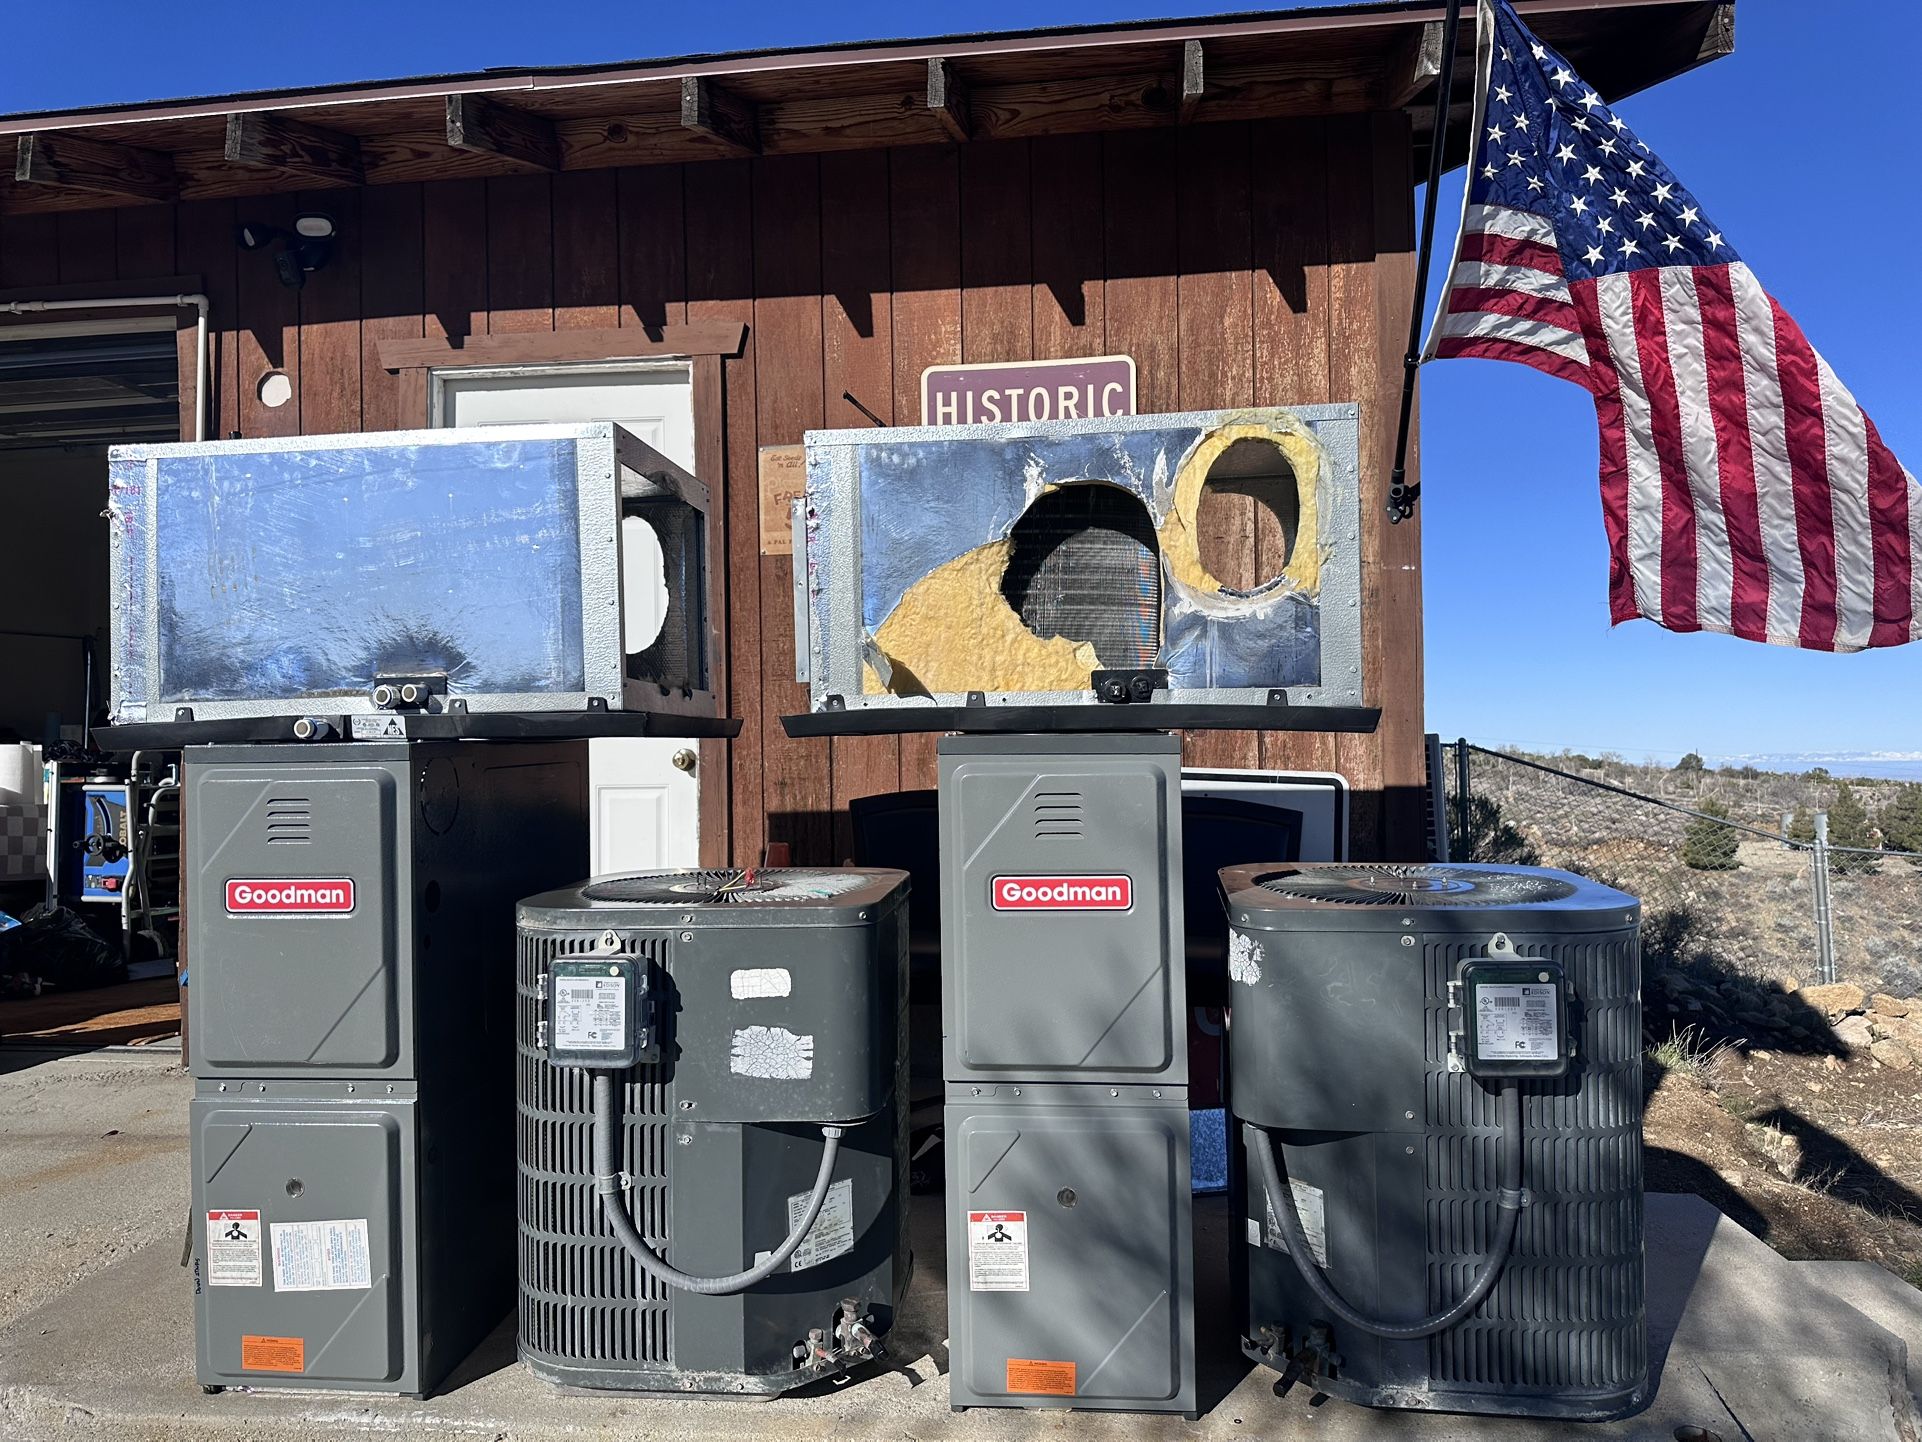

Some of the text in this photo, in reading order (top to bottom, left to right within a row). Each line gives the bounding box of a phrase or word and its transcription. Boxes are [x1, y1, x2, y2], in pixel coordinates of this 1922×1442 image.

[936, 382, 1124, 425] HISTORIC
[119, 810, 127, 847] OBALT
[234, 885, 345, 904] Goodman
[1002, 882, 1121, 902] Goodman
